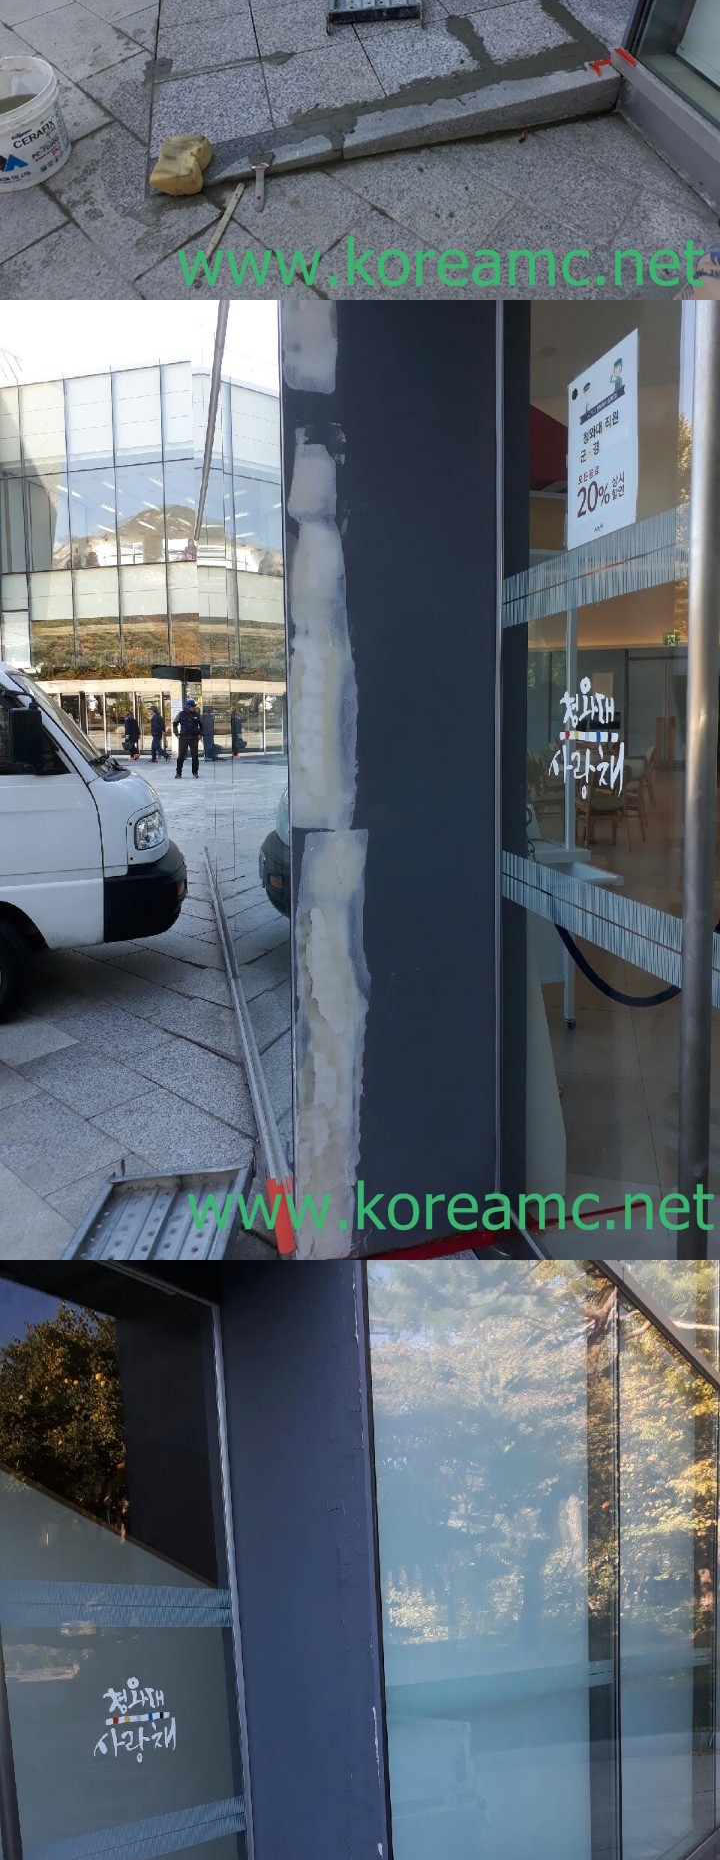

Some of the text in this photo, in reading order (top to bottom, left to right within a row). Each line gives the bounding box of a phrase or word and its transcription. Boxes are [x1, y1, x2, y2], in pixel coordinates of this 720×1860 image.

[13, 118, 55, 149] CERAFIX
[583, 409, 620, 445] 청와대 직원
[611, 471, 625, 488] 상시
[577, 480, 610, 518] 20%
